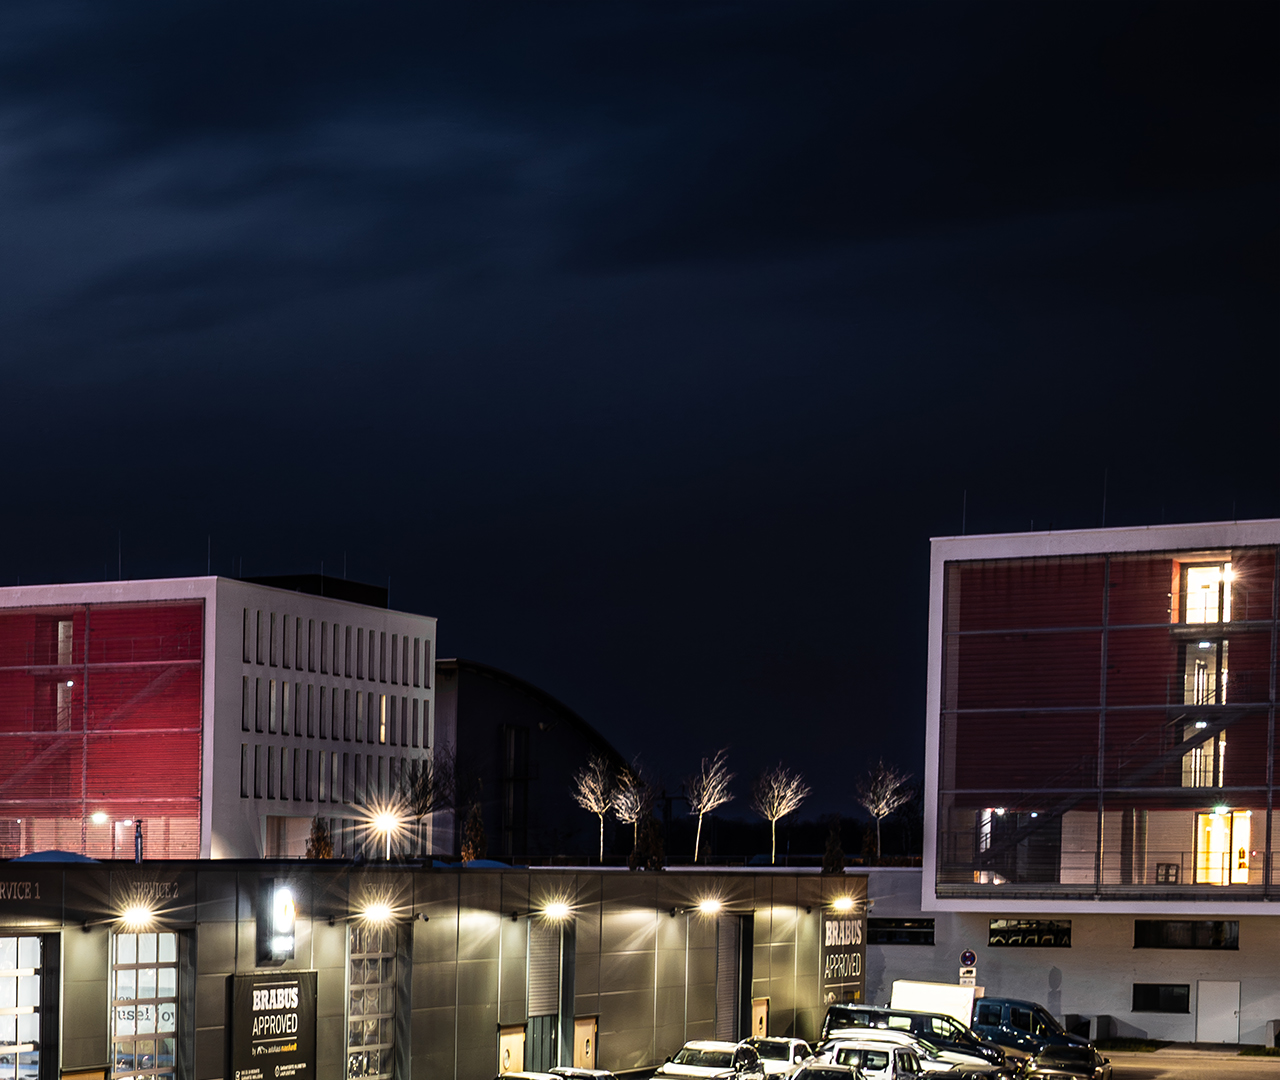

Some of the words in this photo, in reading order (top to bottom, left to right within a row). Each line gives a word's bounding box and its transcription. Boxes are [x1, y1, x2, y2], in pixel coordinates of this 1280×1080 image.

[34, 881, 41, 900] 1
[173, 882, 179, 899] 2
[825, 920, 863, 947] BRABUS
[252, 987, 299, 1012] BRABUS
[252, 1013, 298, 1036] APPROVED
